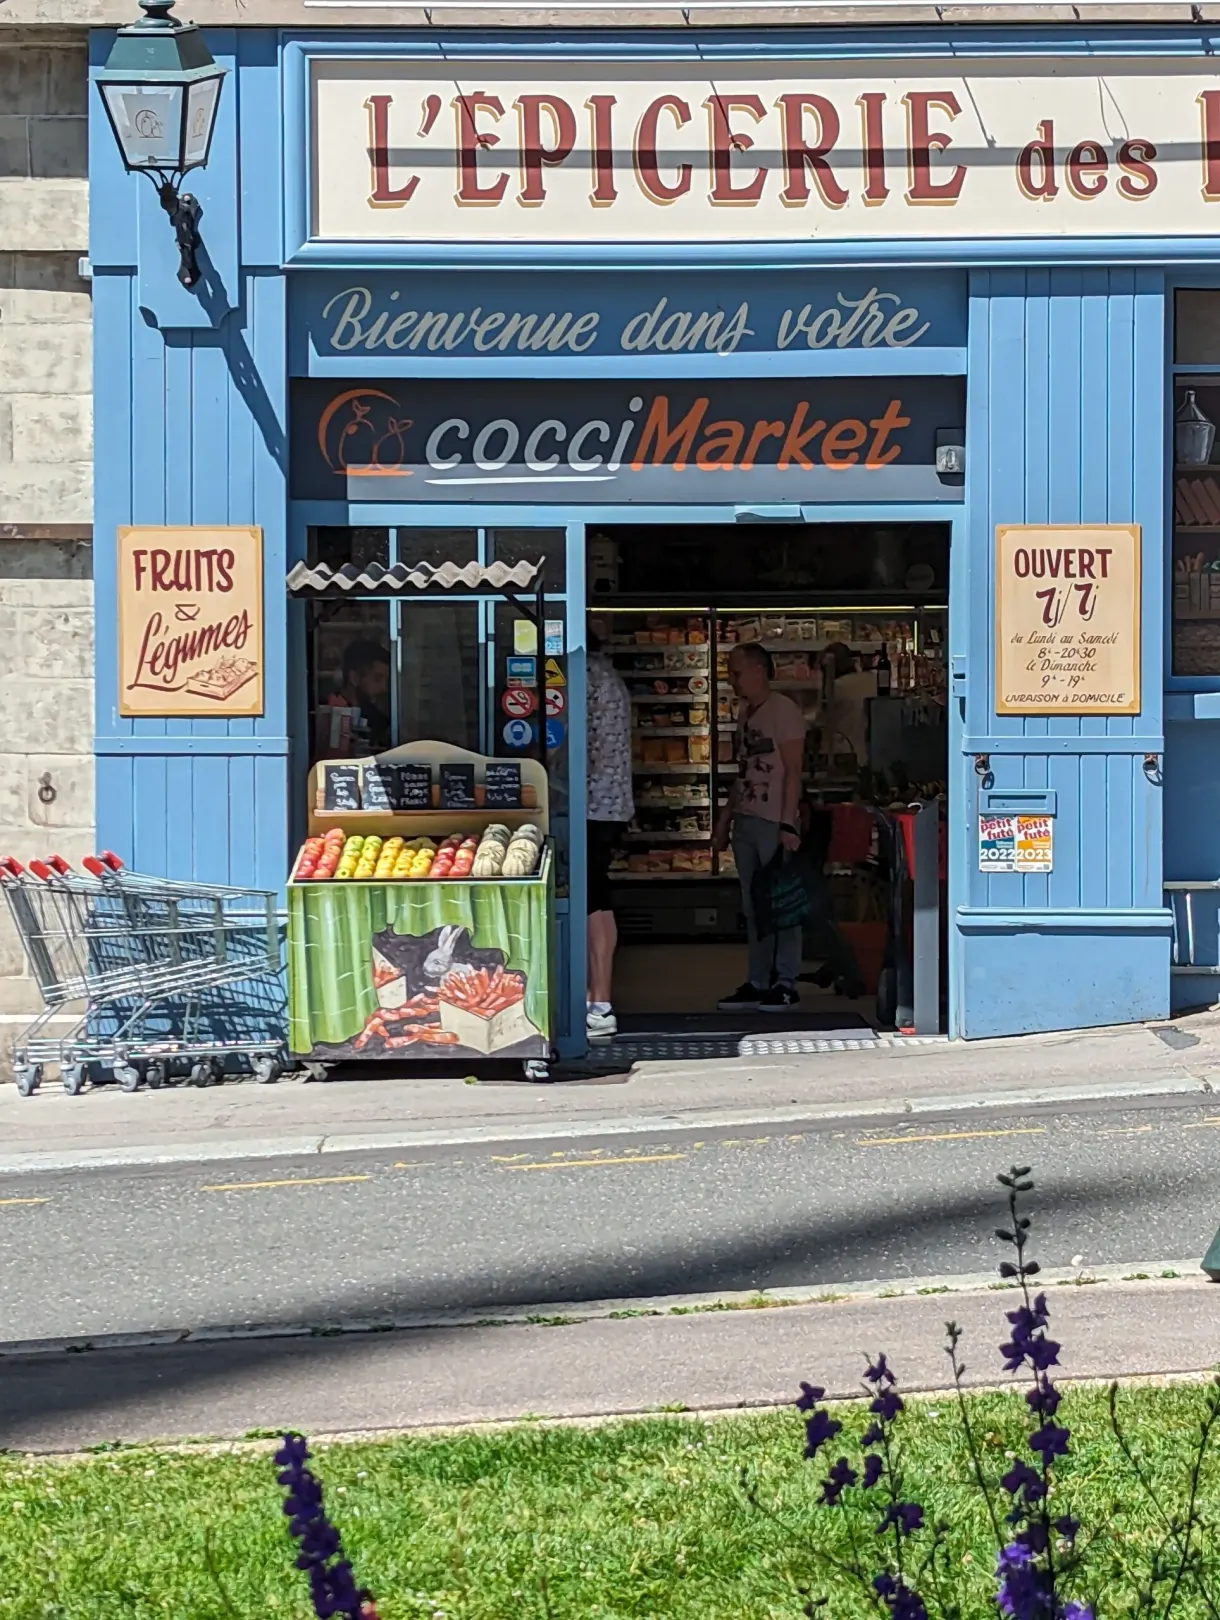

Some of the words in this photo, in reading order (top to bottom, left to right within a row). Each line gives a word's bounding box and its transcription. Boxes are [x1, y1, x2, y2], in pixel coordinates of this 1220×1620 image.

[1016, 119, 1159, 202] des
[323, 287, 600, 352] Bienvenue
[620, 296, 755, 357] dans
[777, 287, 931, 350] votre
[133, 548, 235, 593] FRUITS
[1014, 548, 1113, 579] OUVERT
[174, 603, 201, 621] &
[1027, 630, 1057, 645] Lundi
[1060, 635, 1073, 645] au
[1078, 631, 1120, 645] Samedi
[126, 608, 254, 692] Légumes
[1040, 658, 1098, 672] Dimanche
[1005, 693, 1060, 703] LIVRAISON
[1071, 692, 1126, 703] DOMICILE
[980, 818, 1013, 834] petit
[1016, 818, 1050, 834] petit
[980, 848, 1016, 860] 2022
[1016, 848, 1052, 860] 2023
